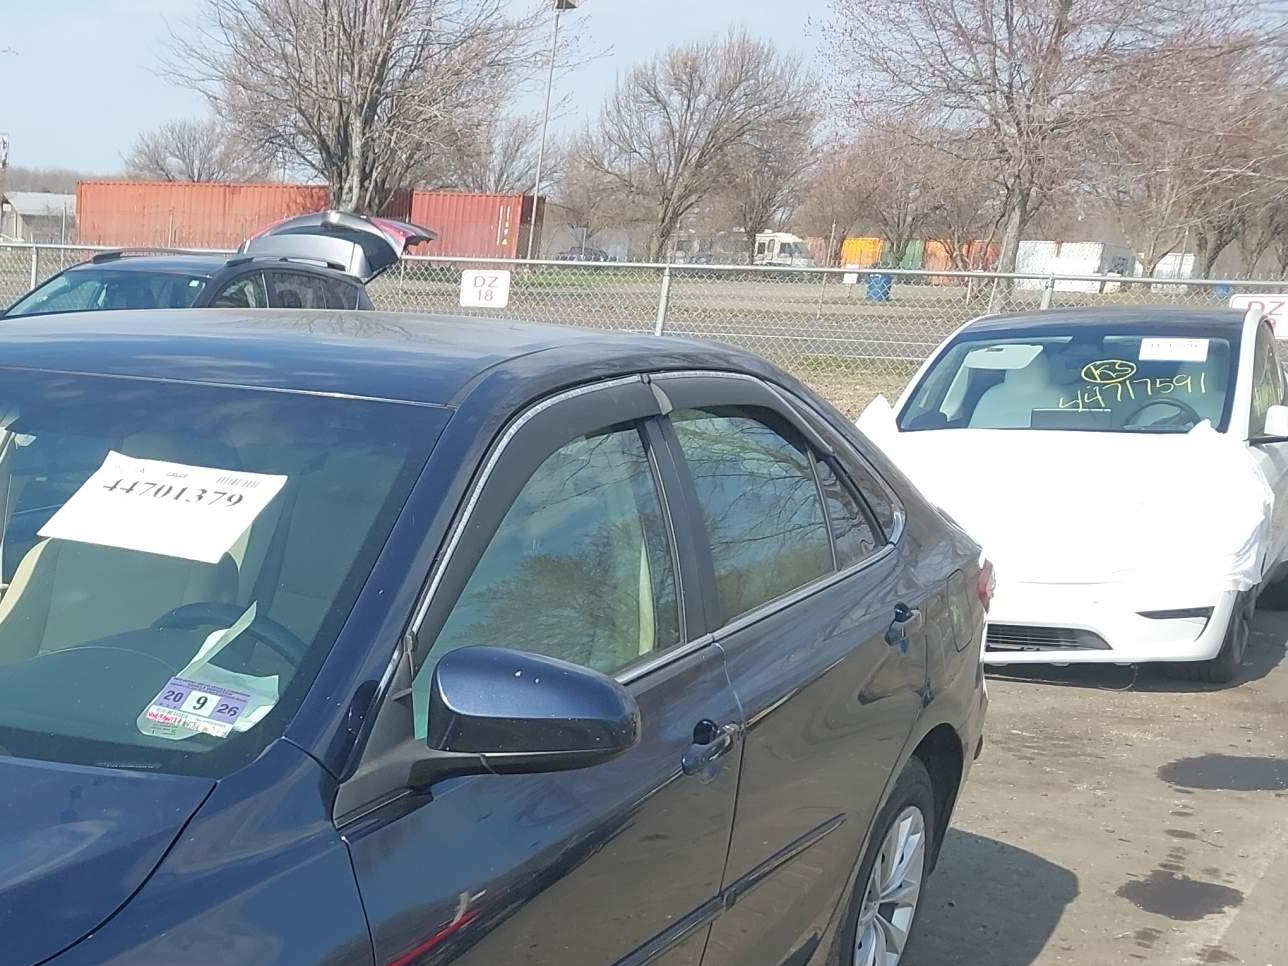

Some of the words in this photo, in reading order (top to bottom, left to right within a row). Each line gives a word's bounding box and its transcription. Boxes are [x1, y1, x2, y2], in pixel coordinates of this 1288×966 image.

[473, 275, 499, 287] DZ
[478, 289, 494, 302] 18
[1058, 371, 1206, 412] 44717591
[103, 478, 245, 507] 44701379
[163, 690, 184, 703] 20
[192, 696, 208, 710] 9
[216, 704, 239, 717] 26
